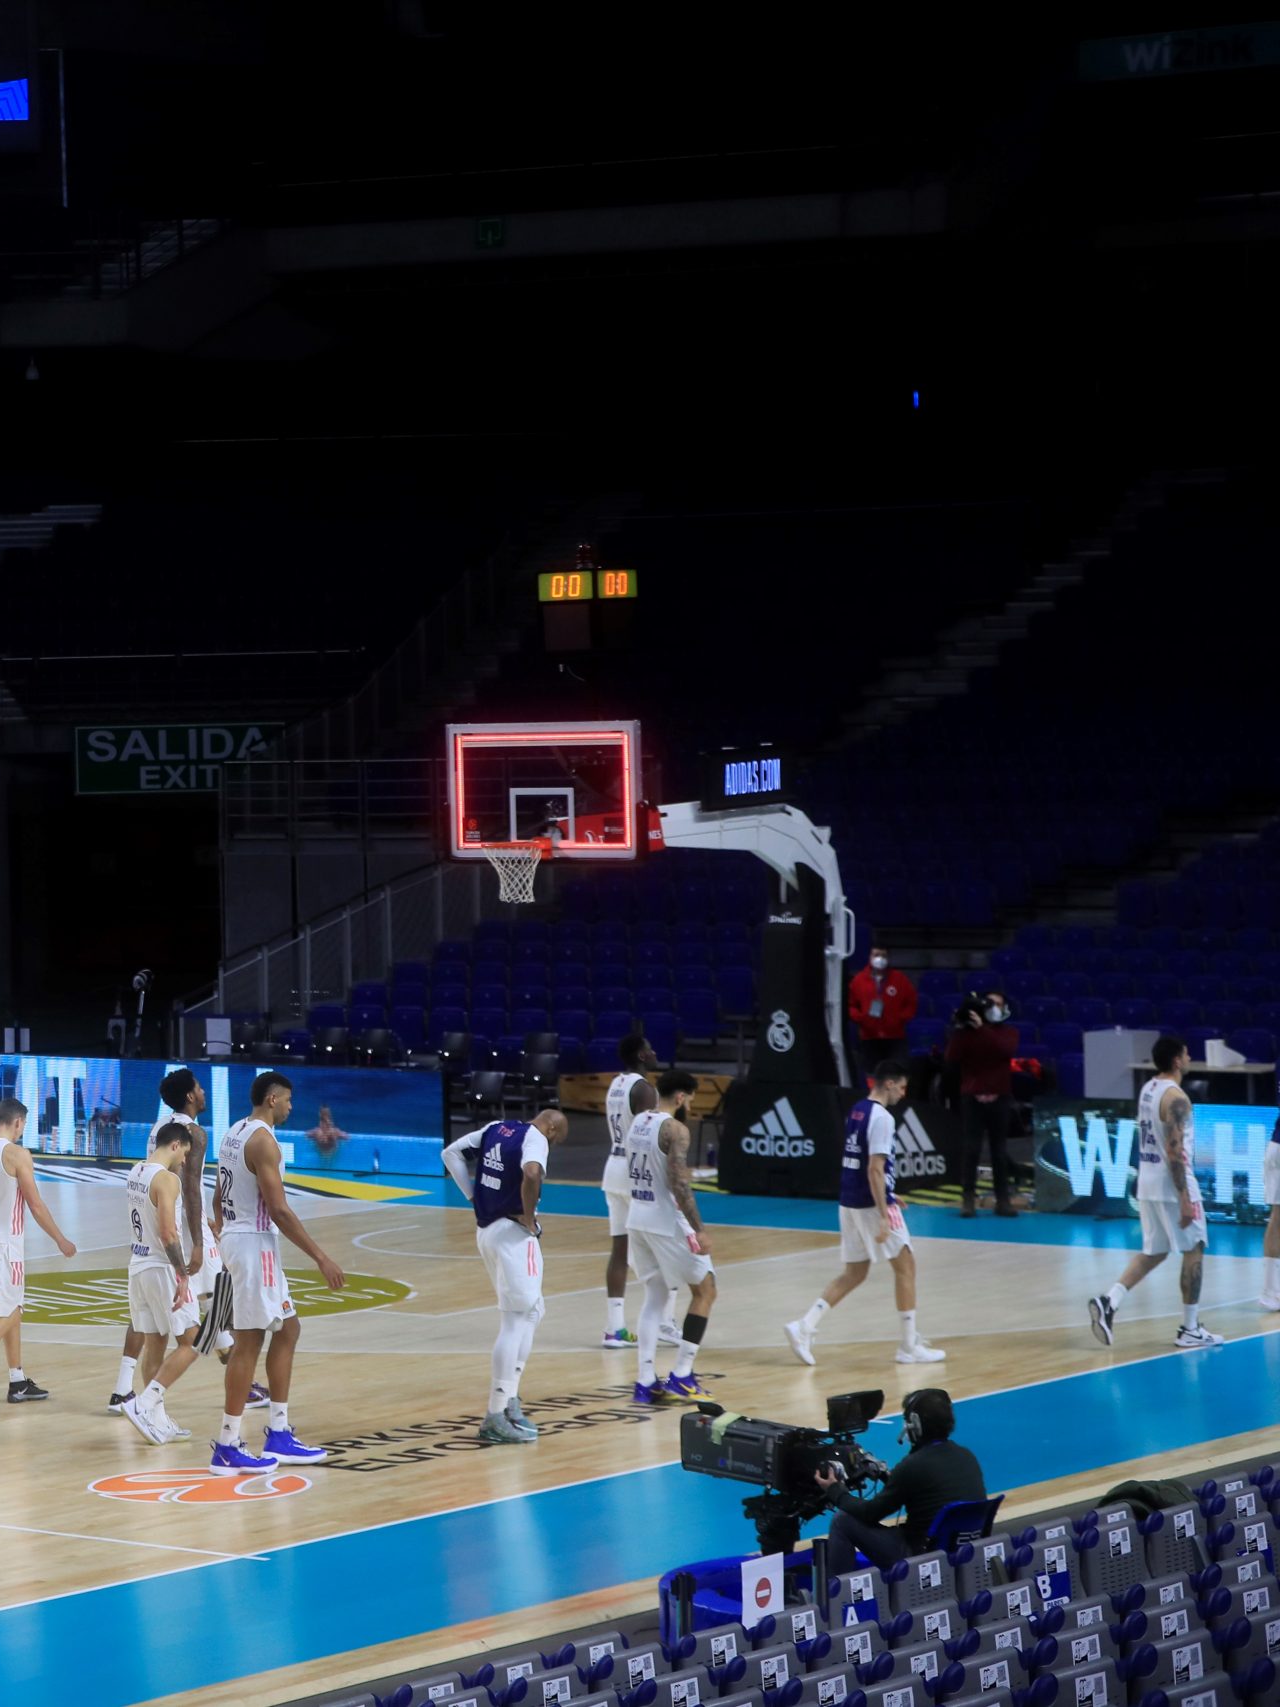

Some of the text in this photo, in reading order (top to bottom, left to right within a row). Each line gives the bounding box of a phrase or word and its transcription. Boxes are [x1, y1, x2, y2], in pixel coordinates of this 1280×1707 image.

[86, 727, 268, 763] SALIDA
[140, 764, 221, 789] EXIT
[725, 759, 781, 796] ADIDAS.COM
[20, 1057, 88, 1151] IT
[741, 1135, 816, 1158] adidas
[1058, 1116, 1138, 1198] W
[629, 1152, 653, 1187] 44
[316, 1414, 486, 1457] URKISH
[1037, 1575, 1052, 1599] B
[845, 1606, 860, 1627] A
